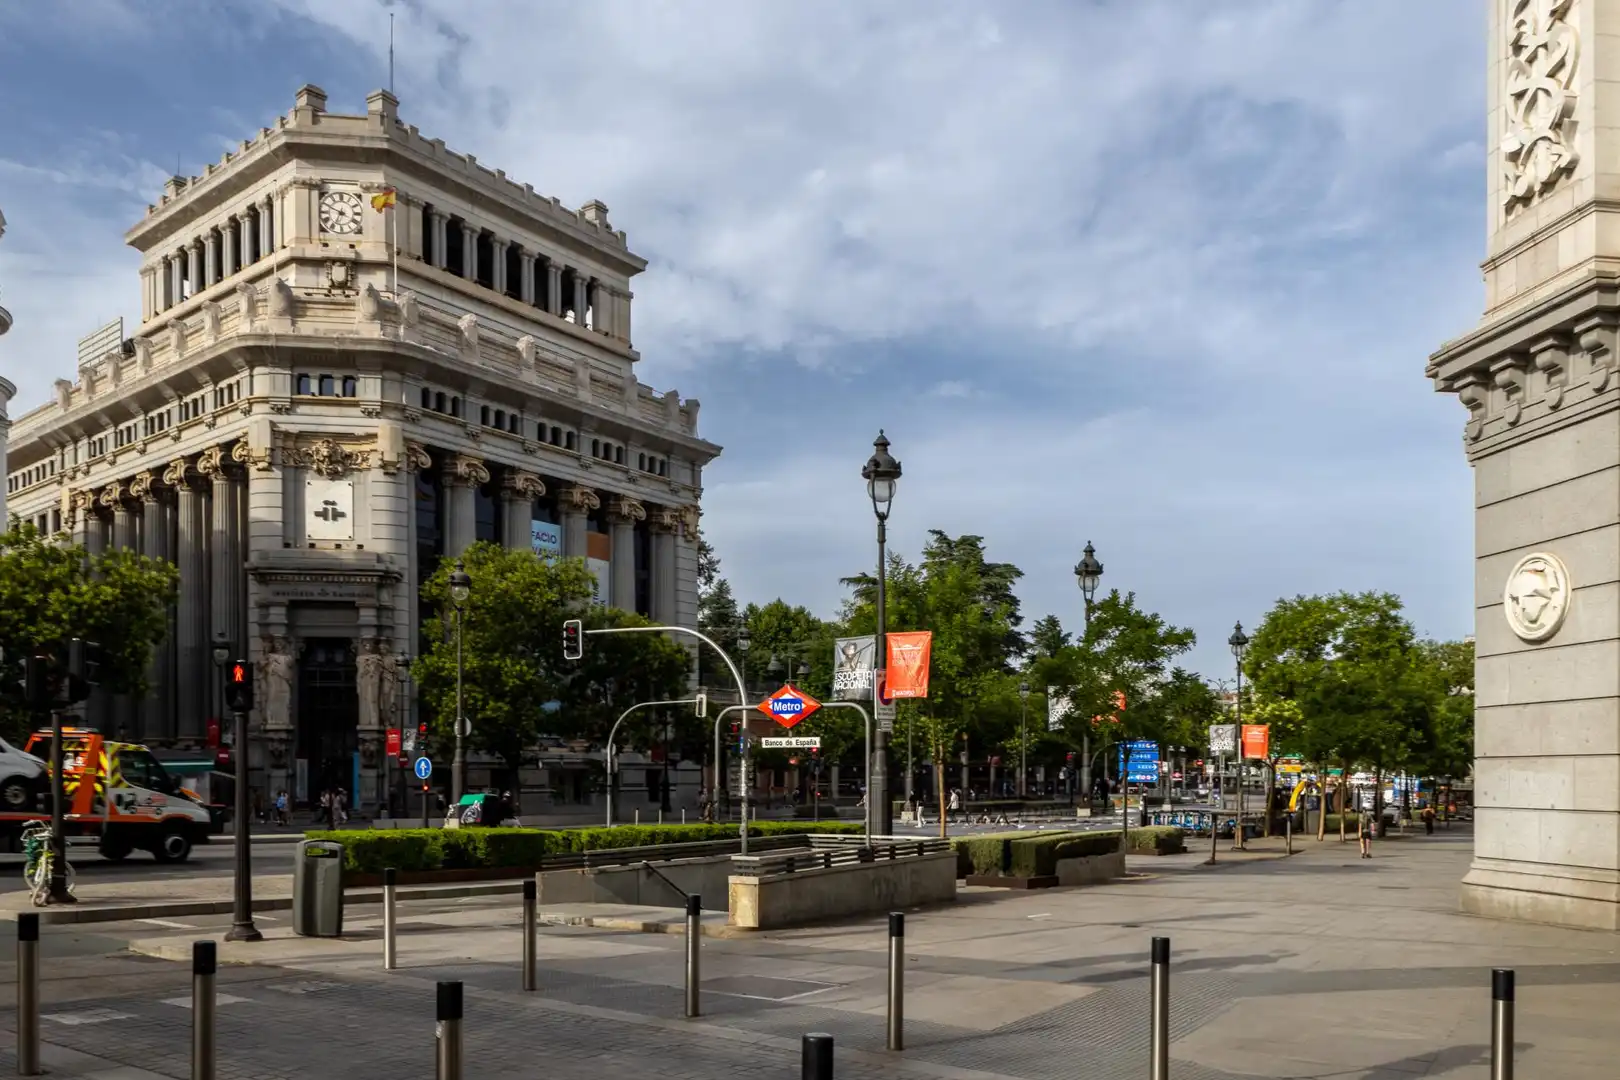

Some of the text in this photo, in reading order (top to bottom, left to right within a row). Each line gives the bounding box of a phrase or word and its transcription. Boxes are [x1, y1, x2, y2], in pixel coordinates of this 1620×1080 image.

[833, 679, 872, 691] NACIONAL
[773, 702, 801, 712] Metro
[795, 738, 817, 747] España
